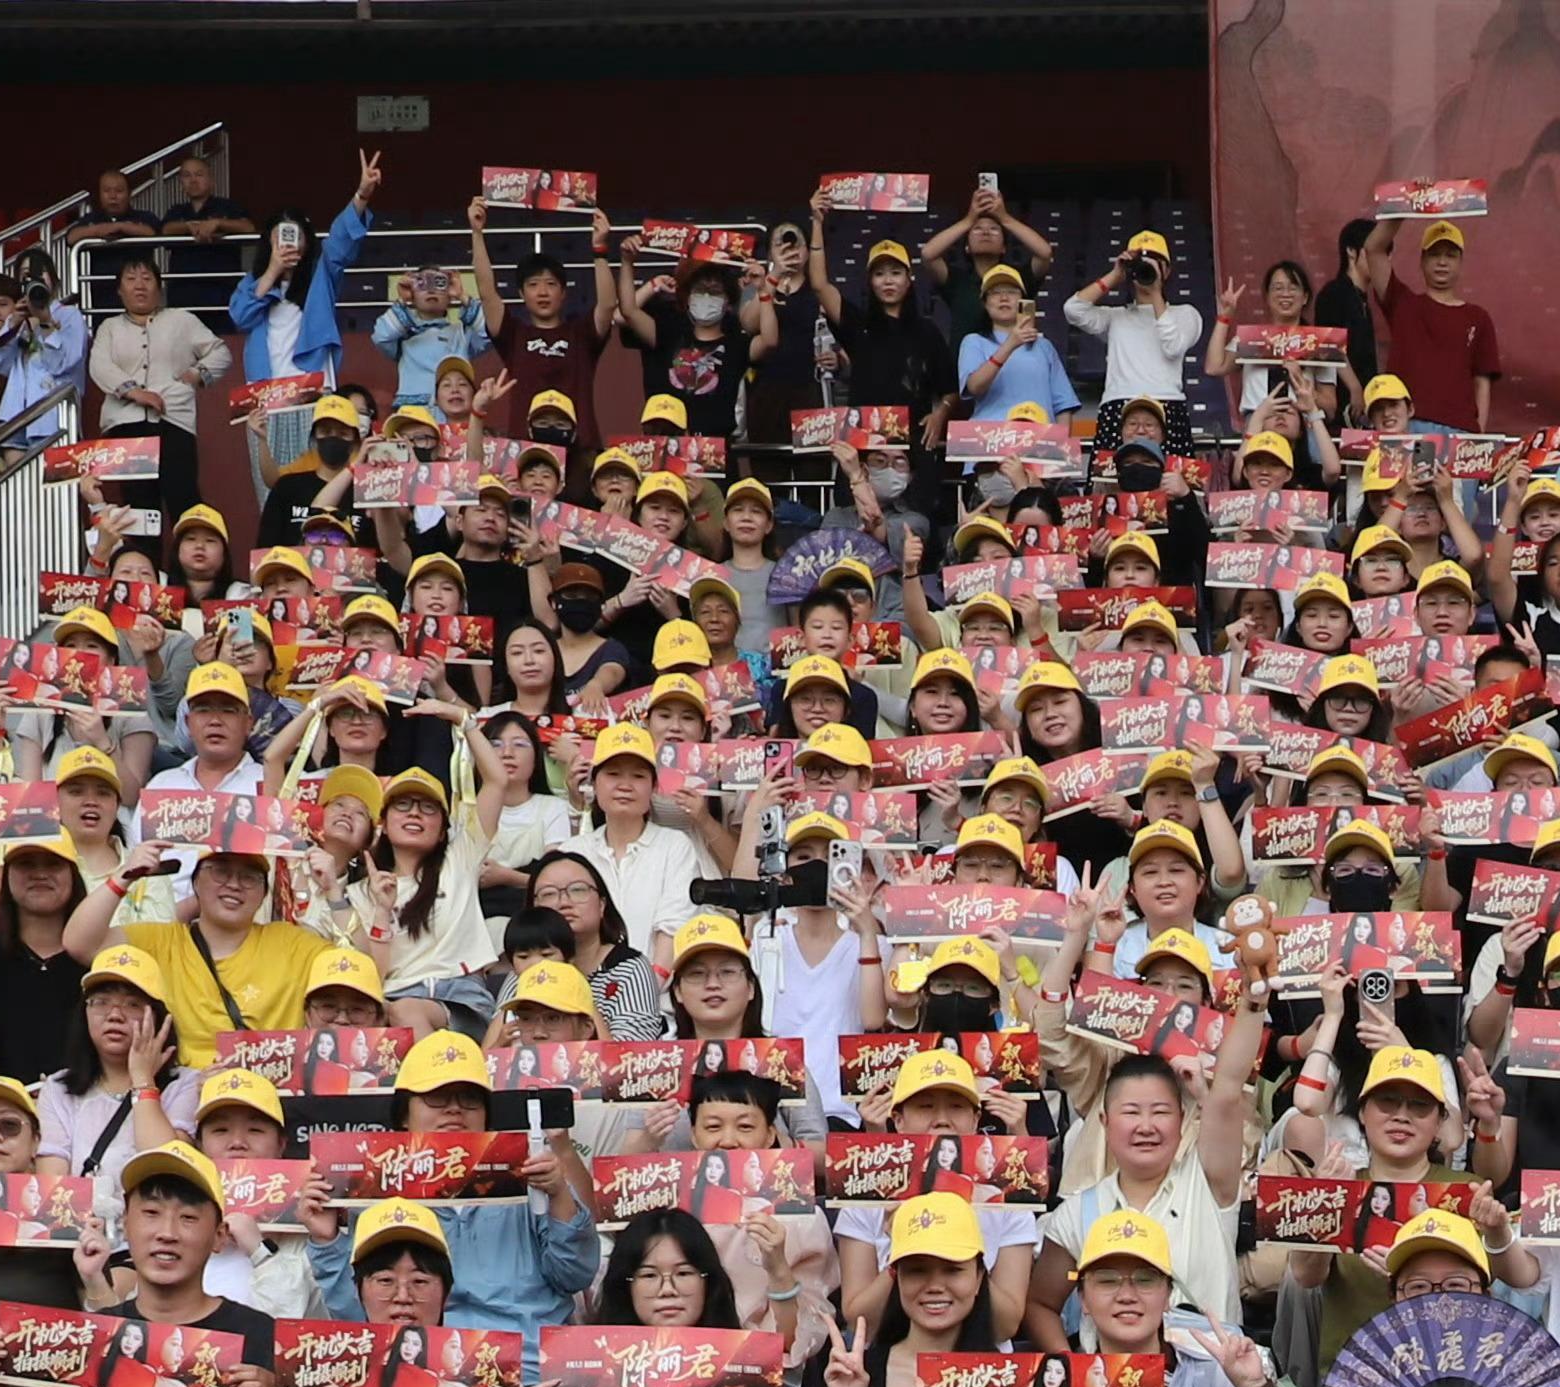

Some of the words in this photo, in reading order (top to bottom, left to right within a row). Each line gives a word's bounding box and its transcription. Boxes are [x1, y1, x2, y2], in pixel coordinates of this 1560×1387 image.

[604, 1159, 682, 1194] 开机大吉
[1266, 1184, 1346, 1215] 开机大吉
[4, 1317, 94, 1347] 开机大吉
[284, 1329, 374, 1364] 开机大吉
[619, 1344, 719, 1387] 陈丽君
